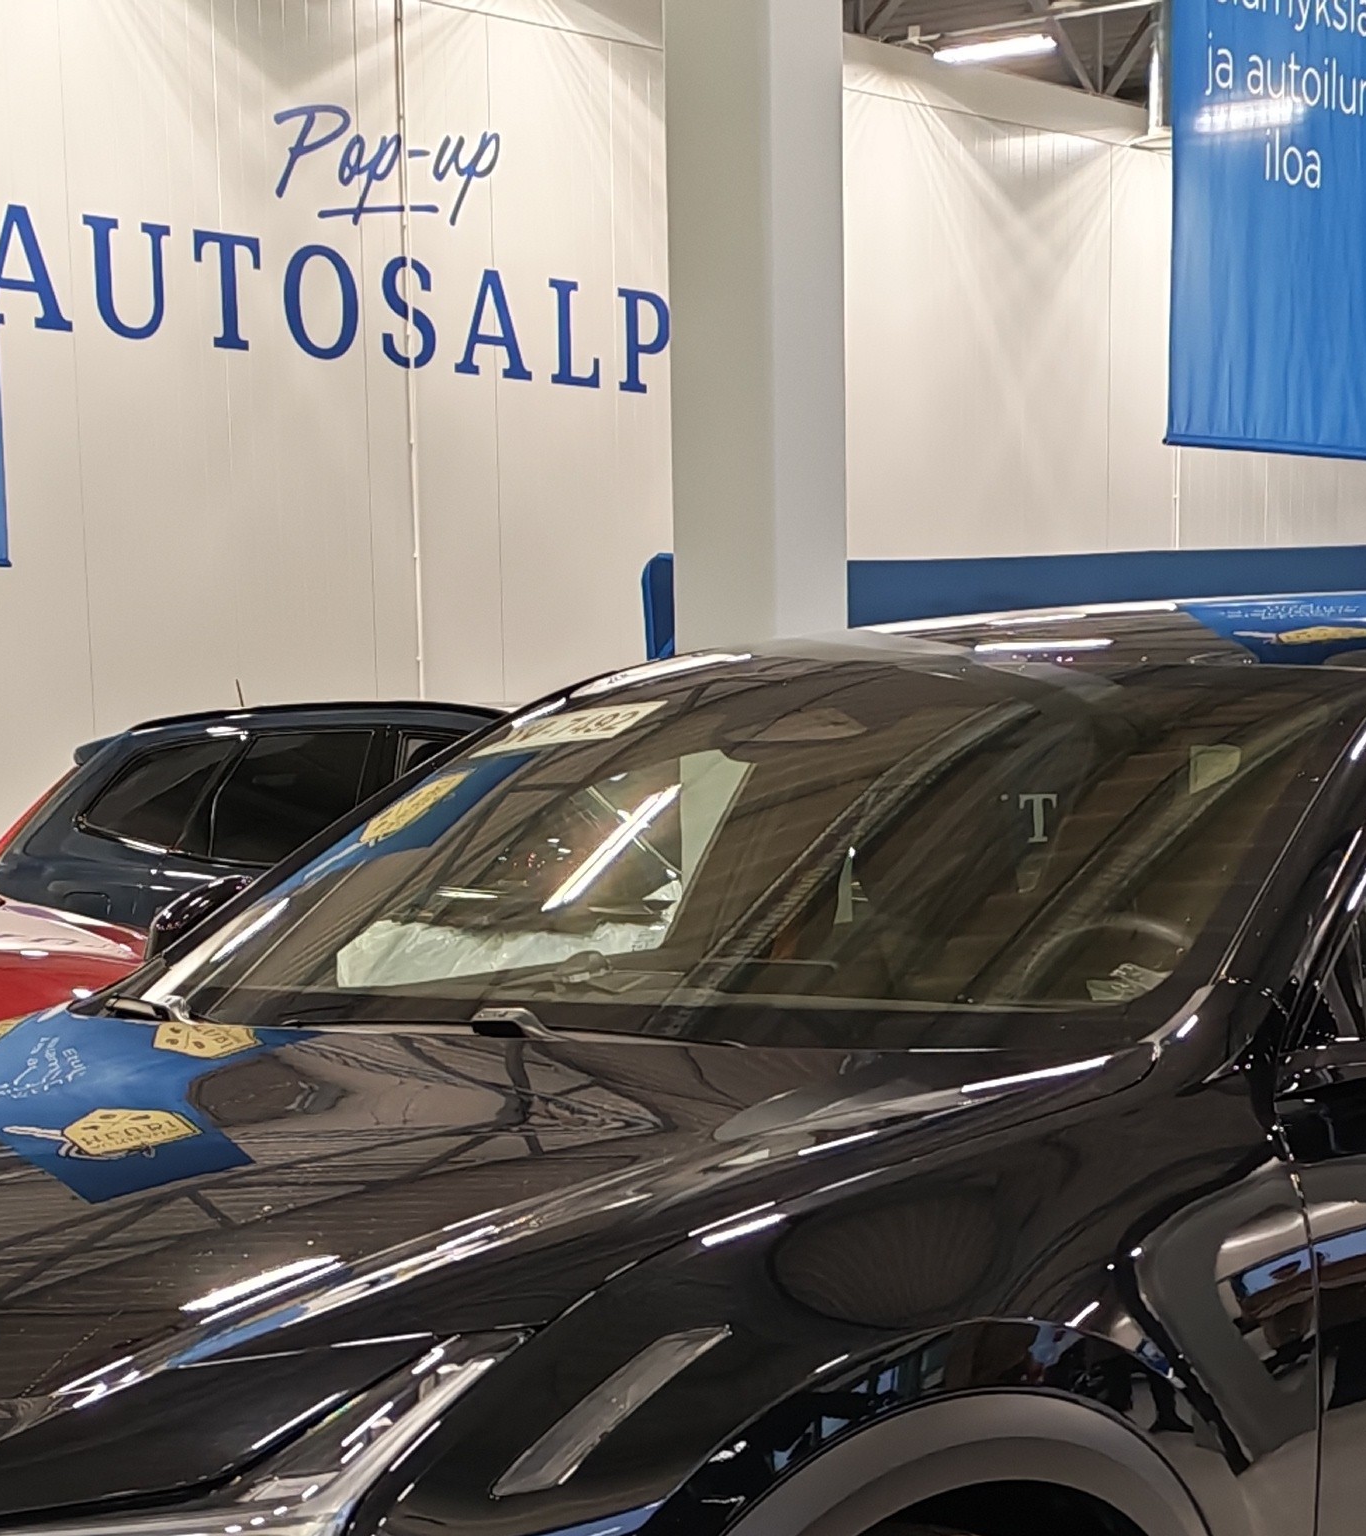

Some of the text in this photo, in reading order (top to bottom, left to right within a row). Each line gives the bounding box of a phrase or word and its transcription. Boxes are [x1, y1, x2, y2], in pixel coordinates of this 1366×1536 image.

[1205, 30, 1234, 96] ja
[273, 103, 502, 226] Pop-up
[1265, 127, 1322, 189] iloa
